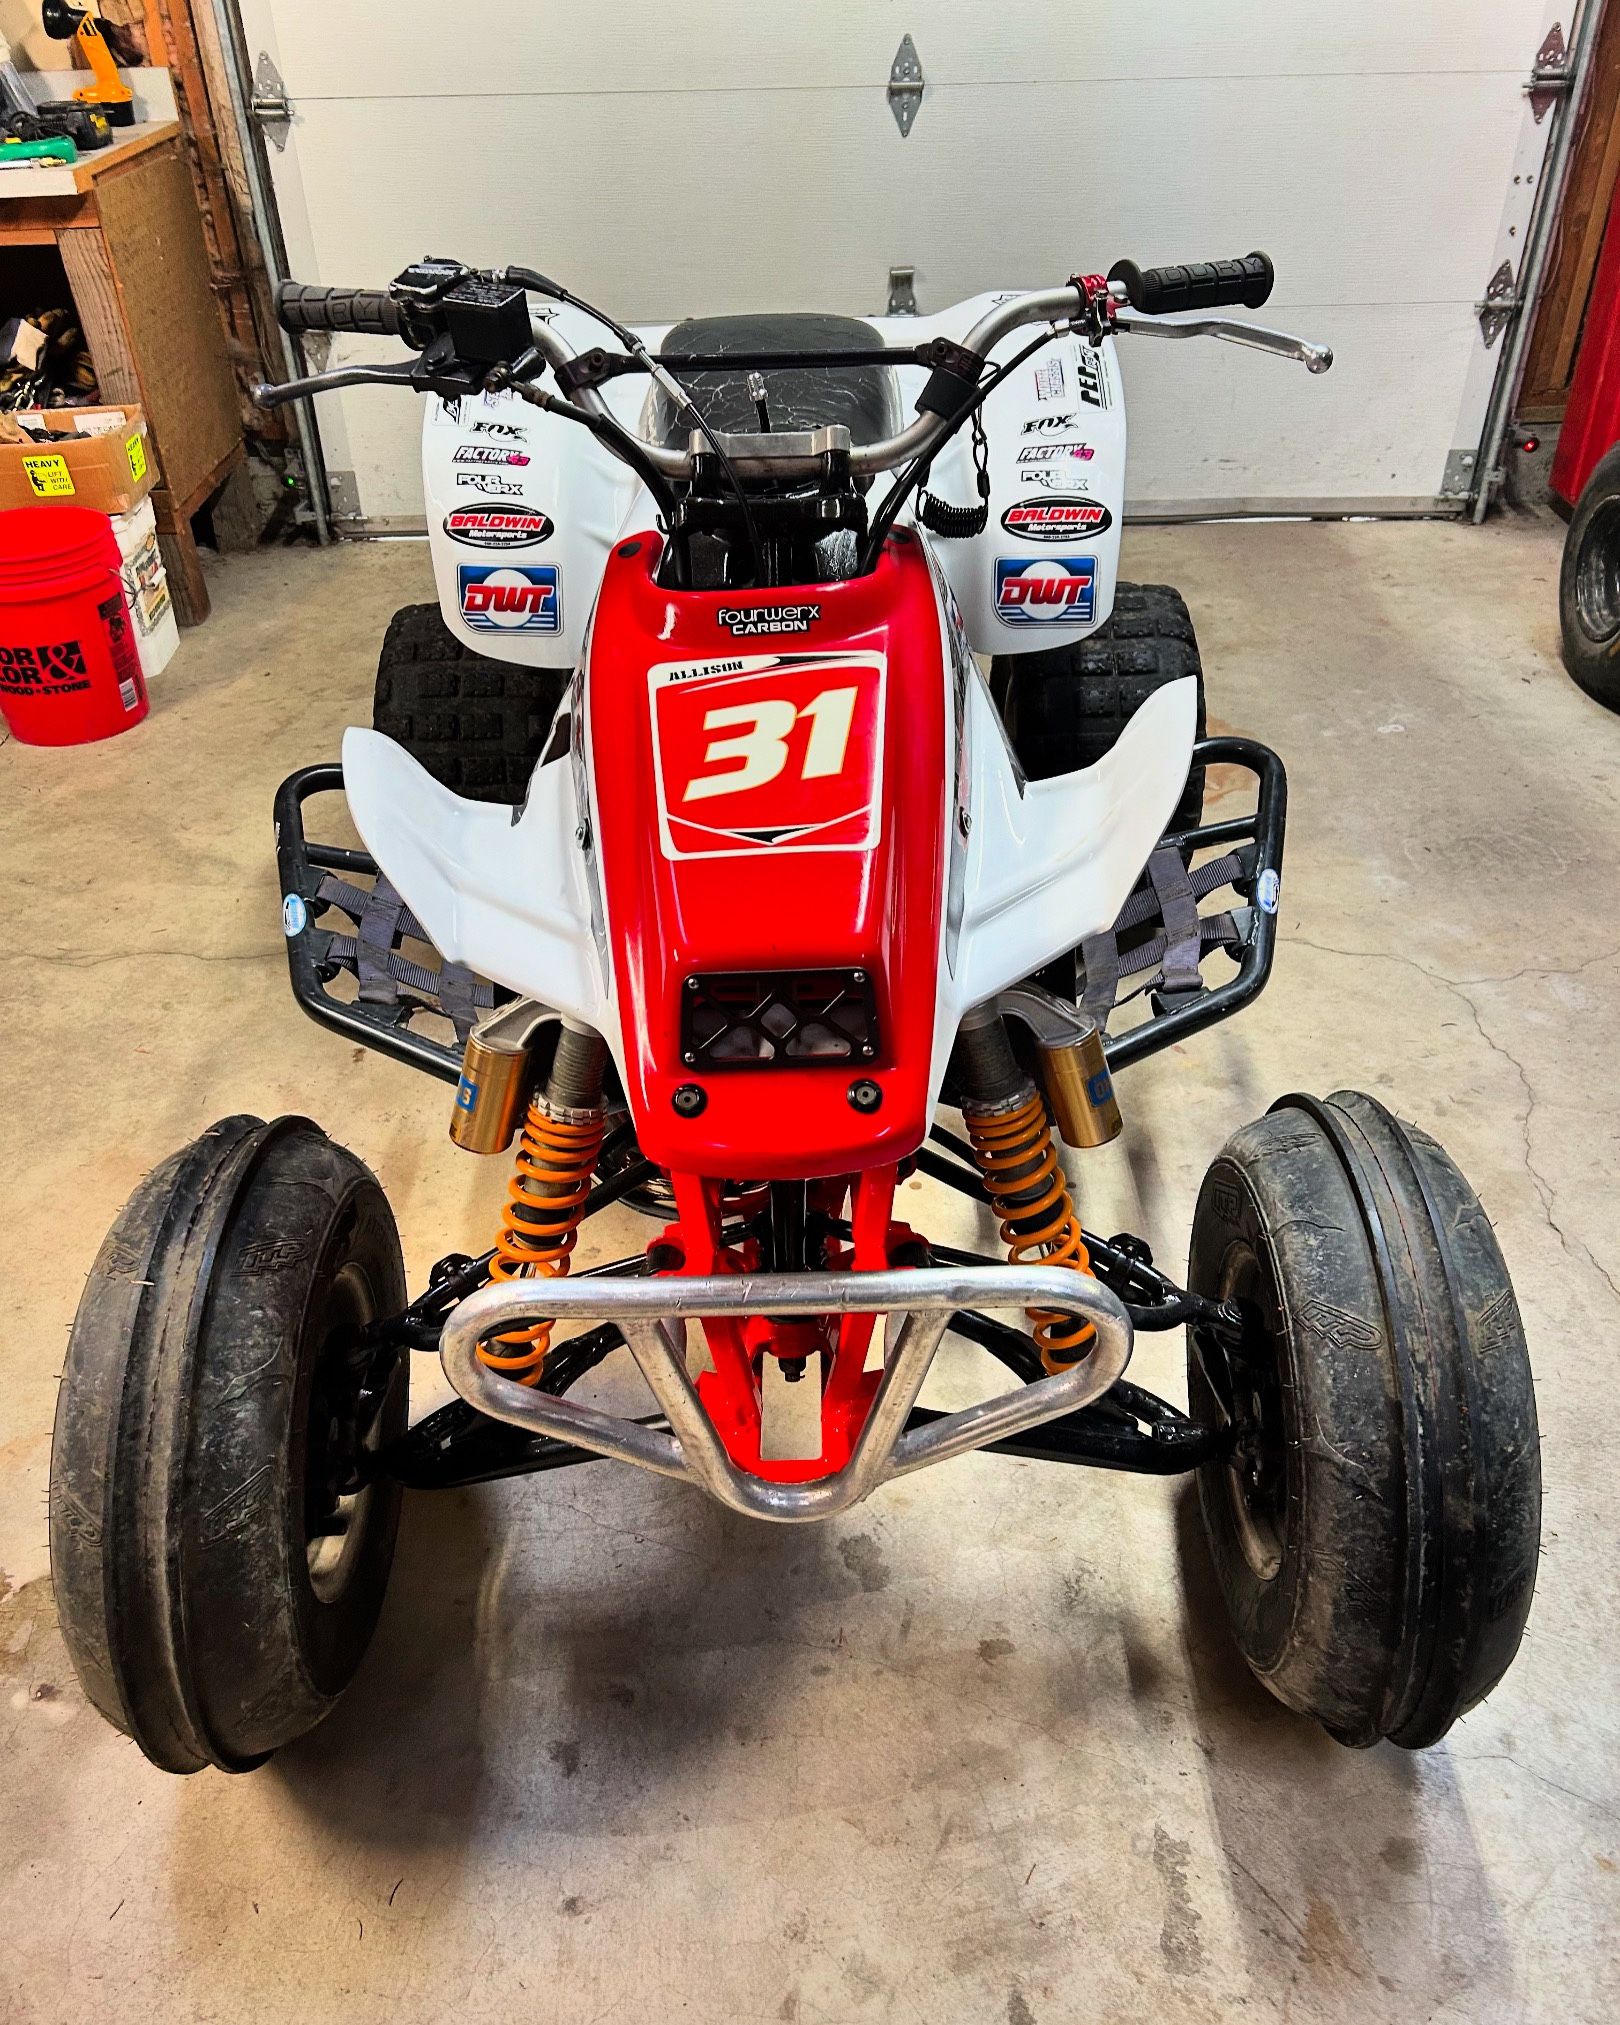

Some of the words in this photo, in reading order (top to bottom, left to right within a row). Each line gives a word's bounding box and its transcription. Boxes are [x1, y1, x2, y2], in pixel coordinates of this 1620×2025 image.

[472, 421, 527, 438] FOX
[1022, 414, 1077, 434] FOX
[455, 446, 520, 461] FACTORY
[1019, 444, 1084, 461] FACTORY
[26, 459, 60, 469] HEAVY
[448, 514, 546, 531] BALDWIN
[1005, 507, 1105, 524] BALDWIN
[468, 530, 528, 540] Motorsports
[1027, 523, 1087, 532] Motorsports
[464, 584, 554, 614] DWT
[999, 577, 1092, 605] DWT
[718, 605, 820, 625] fourwerx
[732, 620, 808, 635] CARBON
[0, 666, 43, 684] OR
[668, 661, 743, 682] ALLISON
[682, 686, 858, 803] 31
